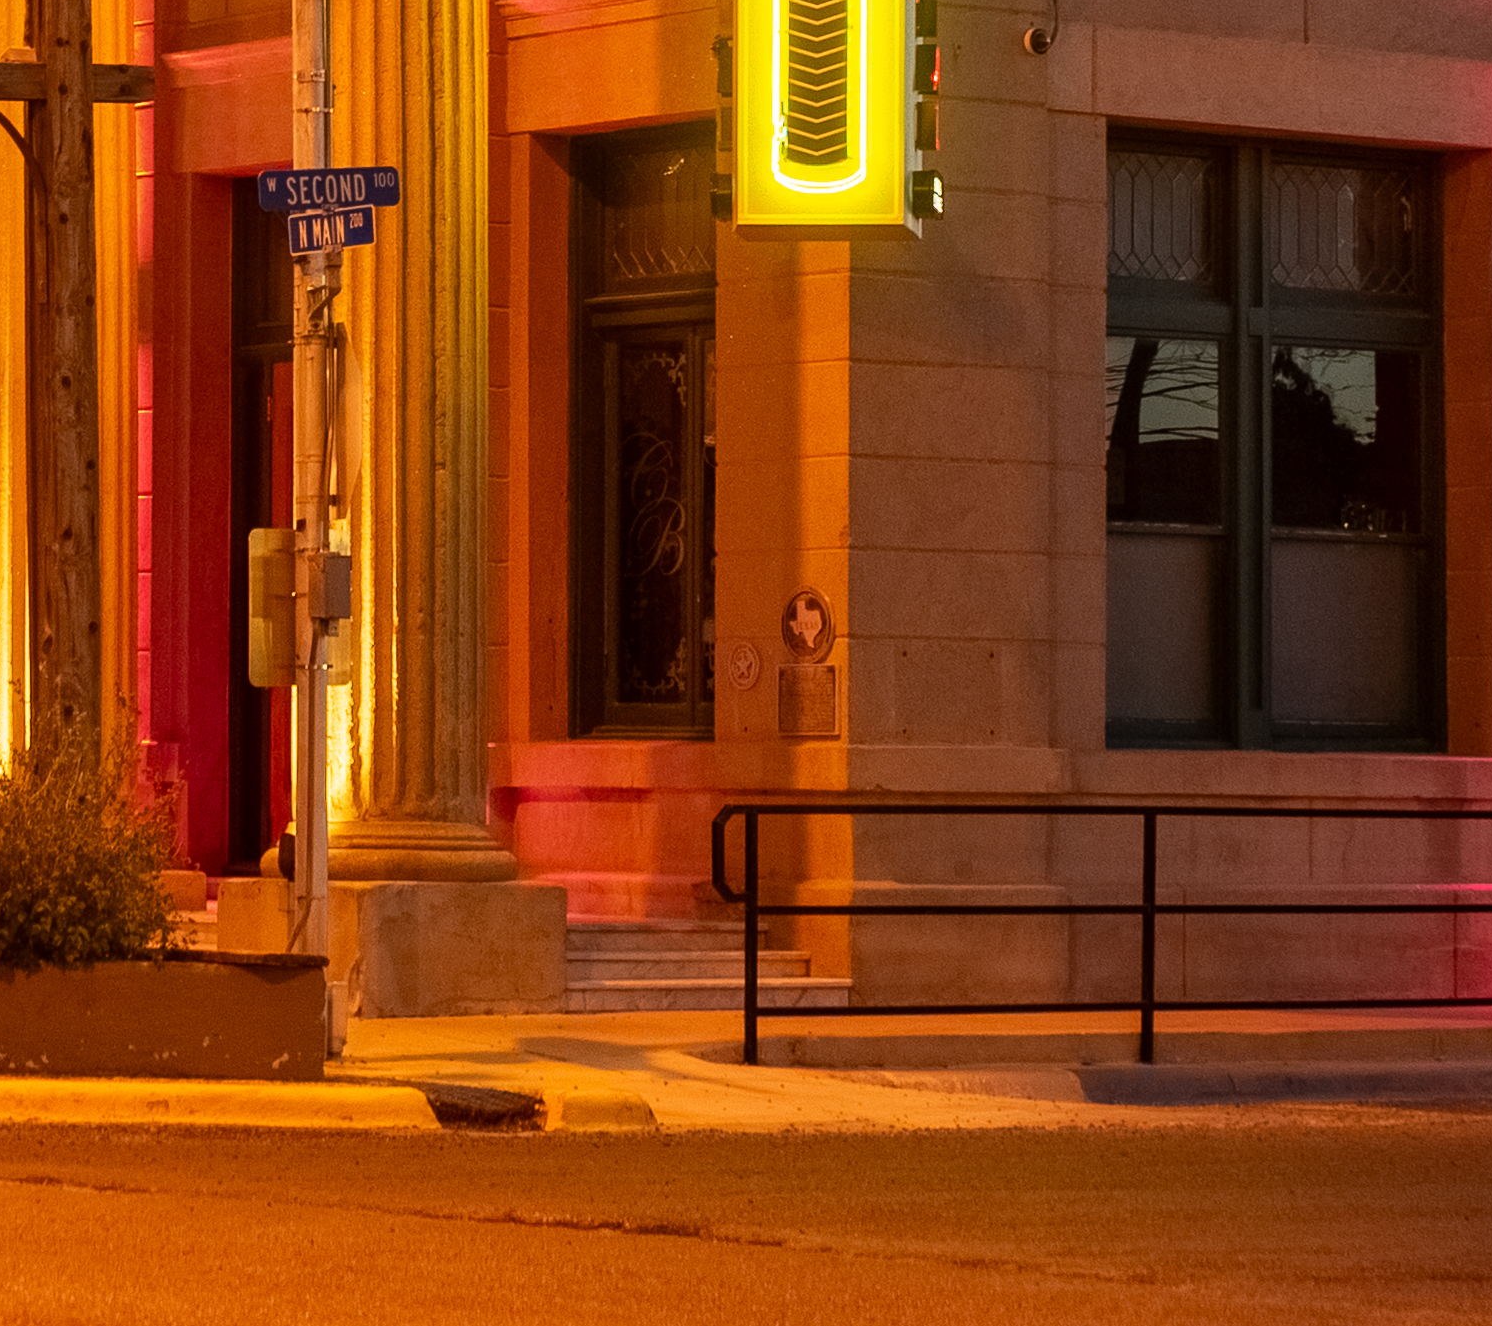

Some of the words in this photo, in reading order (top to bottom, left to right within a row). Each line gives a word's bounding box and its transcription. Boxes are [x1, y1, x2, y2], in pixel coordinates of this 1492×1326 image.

[266, 177, 277, 193] W
[286, 173, 366, 205] SECOND
[373, 172, 395, 188] 100
[298, 219, 308, 249] N
[312, 215, 345, 248] MAIN
[349, 212, 364, 229] 200
